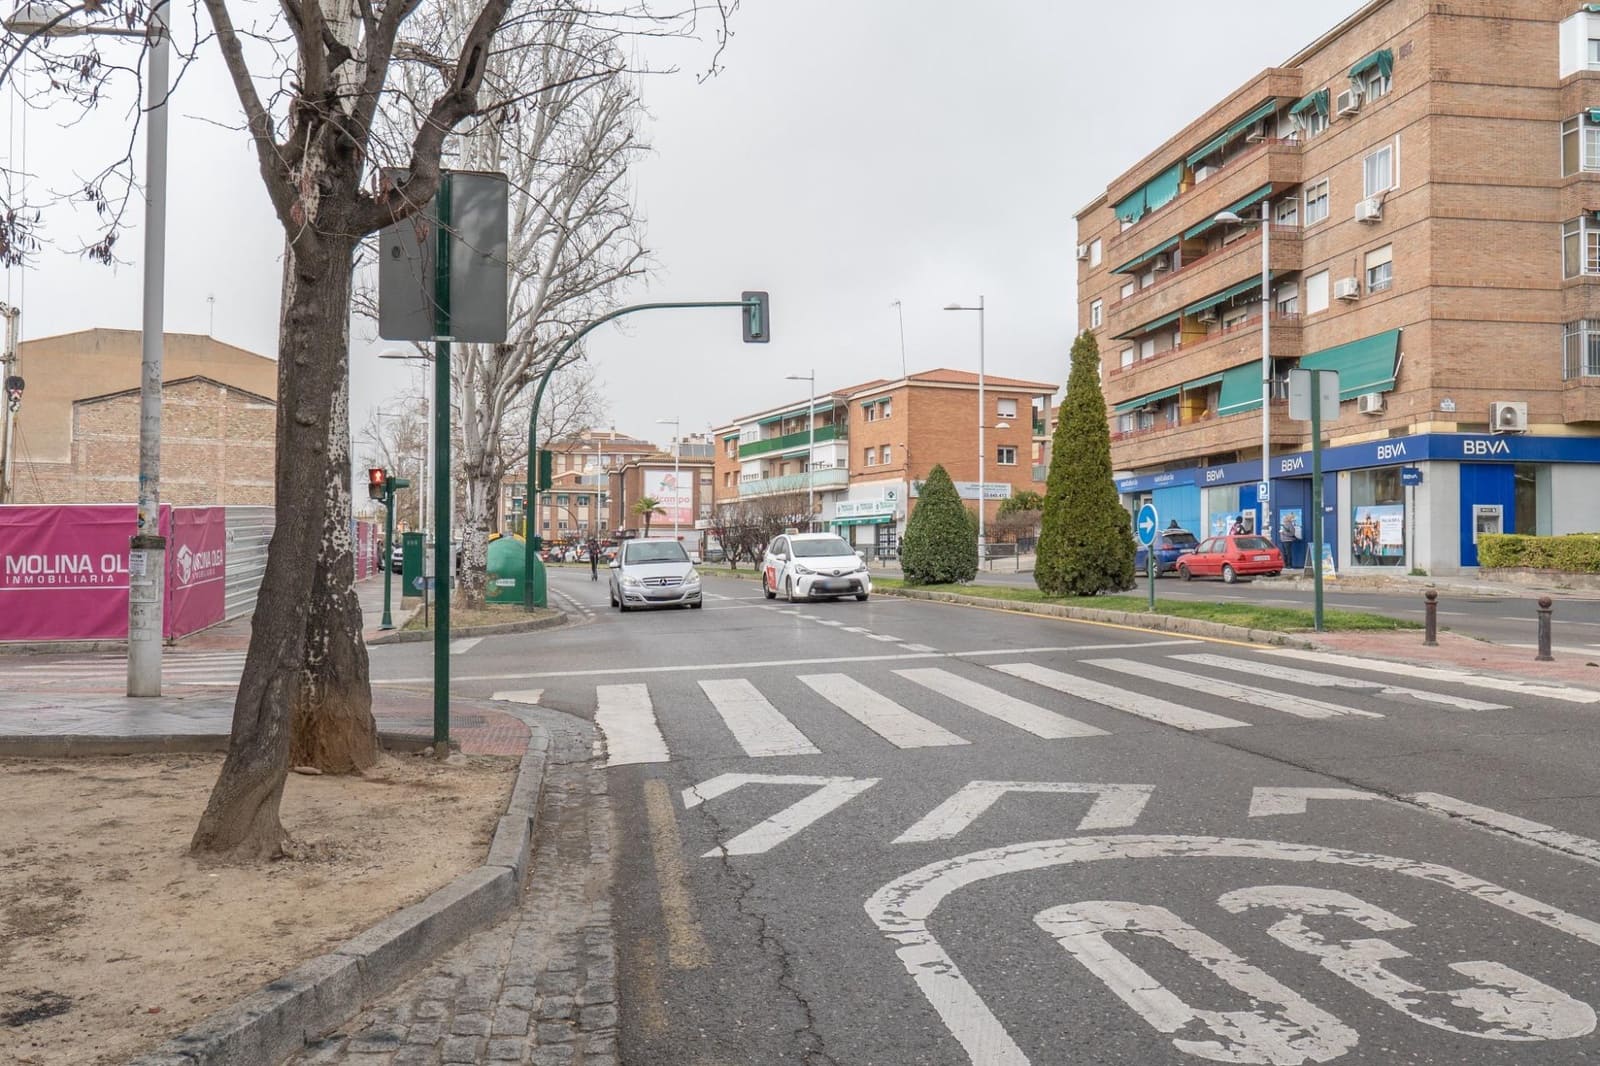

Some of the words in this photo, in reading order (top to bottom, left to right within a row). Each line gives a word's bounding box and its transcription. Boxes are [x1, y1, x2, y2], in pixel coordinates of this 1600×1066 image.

[1377, 441, 1406, 460] BBVA
[1463, 439, 1511, 456] BBVA
[1281, 456, 1304, 473] BBVA
[1206, 469, 1225, 482] BBVA
[6, 554, 93, 574] MOLINA
[100, 554, 129, 574] OL
[6, 574, 114, 585] INMOBILIARIA
